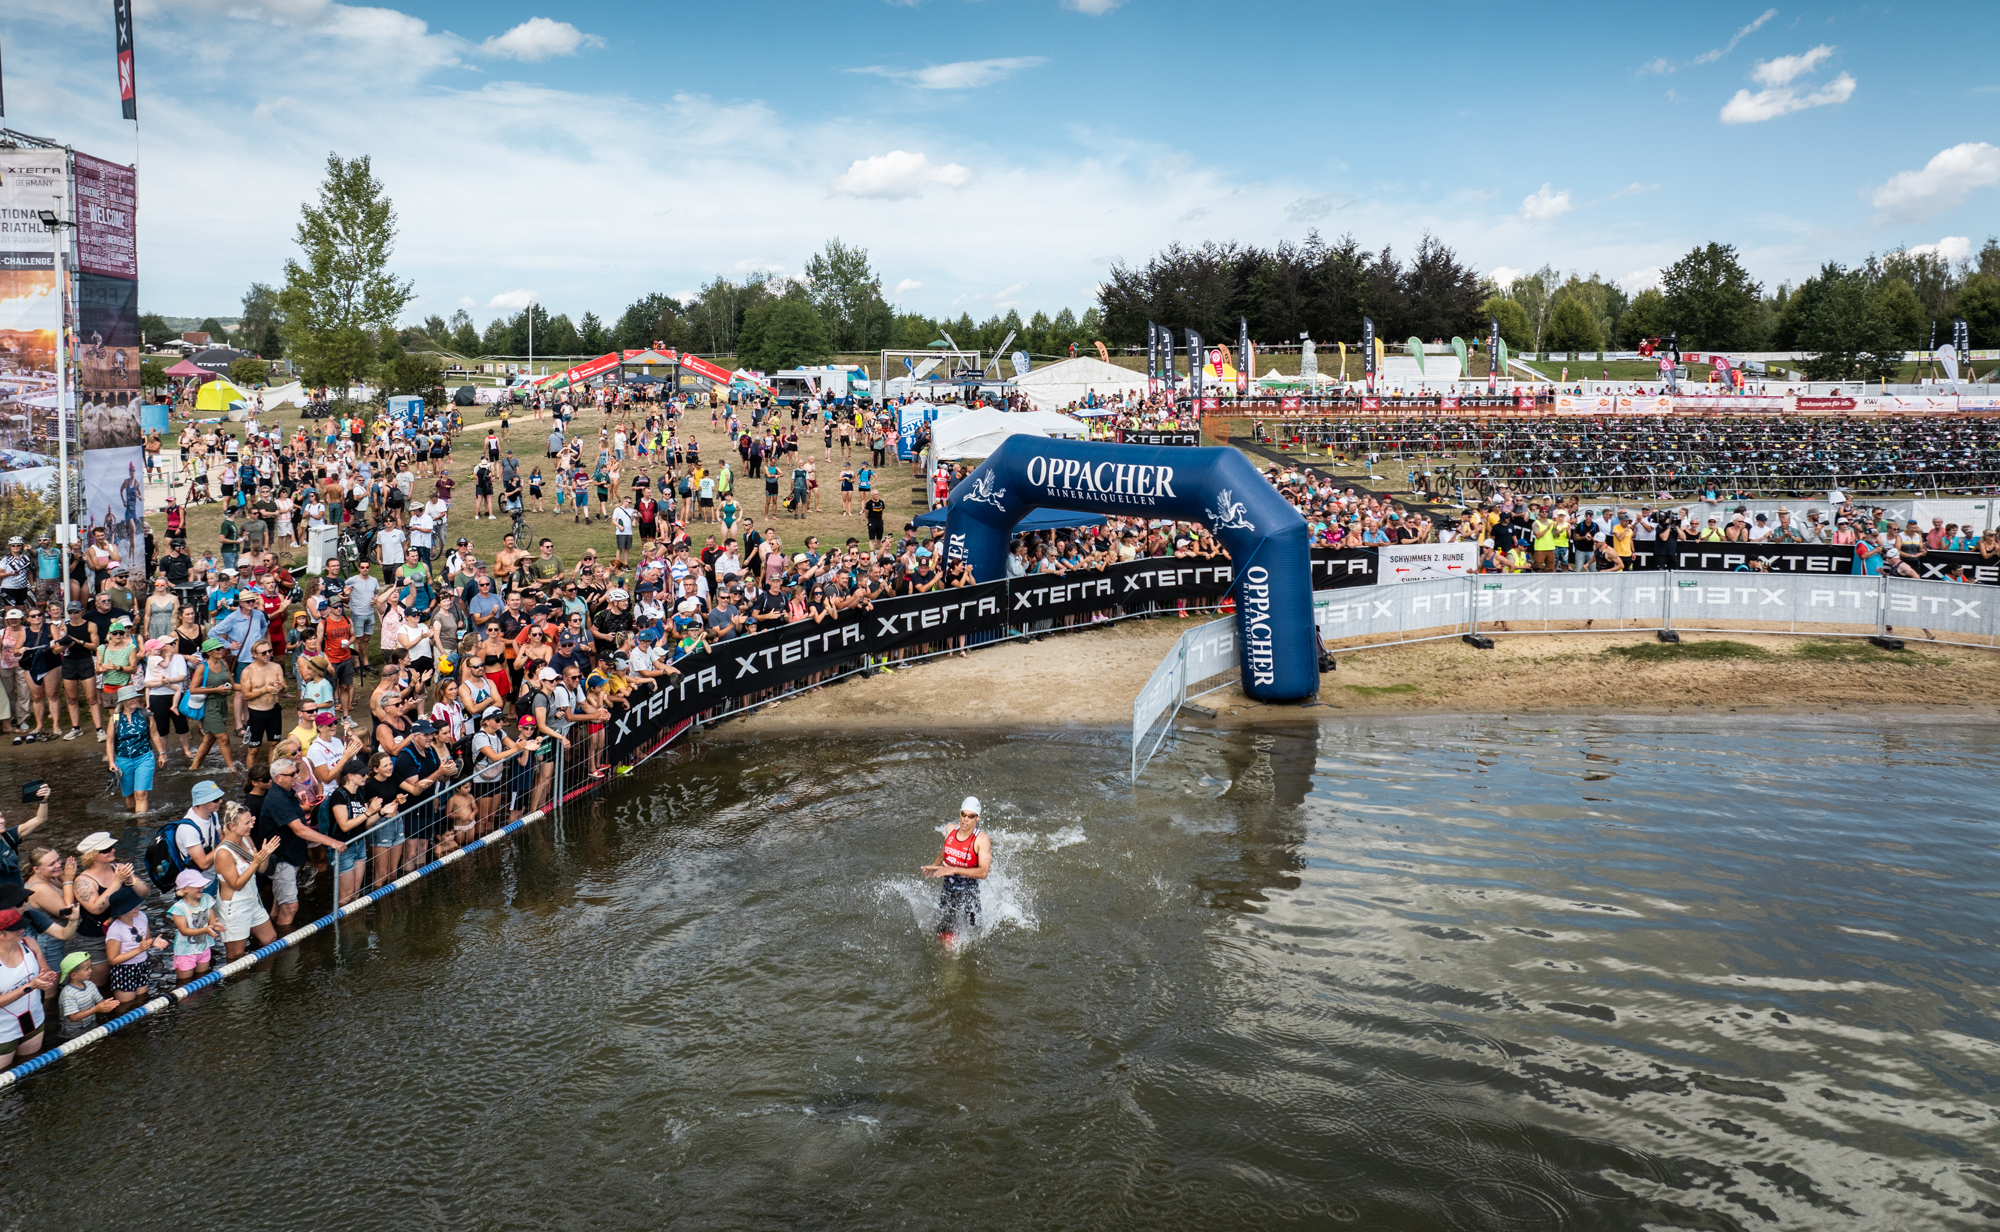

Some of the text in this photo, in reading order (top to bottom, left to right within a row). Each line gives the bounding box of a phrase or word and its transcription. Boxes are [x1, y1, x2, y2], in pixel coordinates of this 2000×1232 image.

[88, 203, 126, 229] WELCOME
[128, 234, 136, 275] WELCOME
[1221, 400, 1276, 408] XTERRA
[1381, 400, 1435, 408] XTERRA
[1832, 400, 1840, 408] für
[1125, 434, 1194, 444] XTERRA
[1027, 456, 1177, 498] OPPACHER
[1047, 488, 1156, 506] MINERALQUELLEN
[1390, 553, 1464, 563] SCHWIMMEN 2. RUNDE
[1014, 578, 1111, 610] XTERRA
[1124, 566, 1233, 593] XTERRA
[876, 596, 996, 638] XTERRA
[1243, 582, 1254, 670] MINERALQUELLEN
[1247, 566, 1274, 687] OPPACHER
[735, 623, 860, 680] XTERRA
[614, 666, 717, 746] XTERRA
